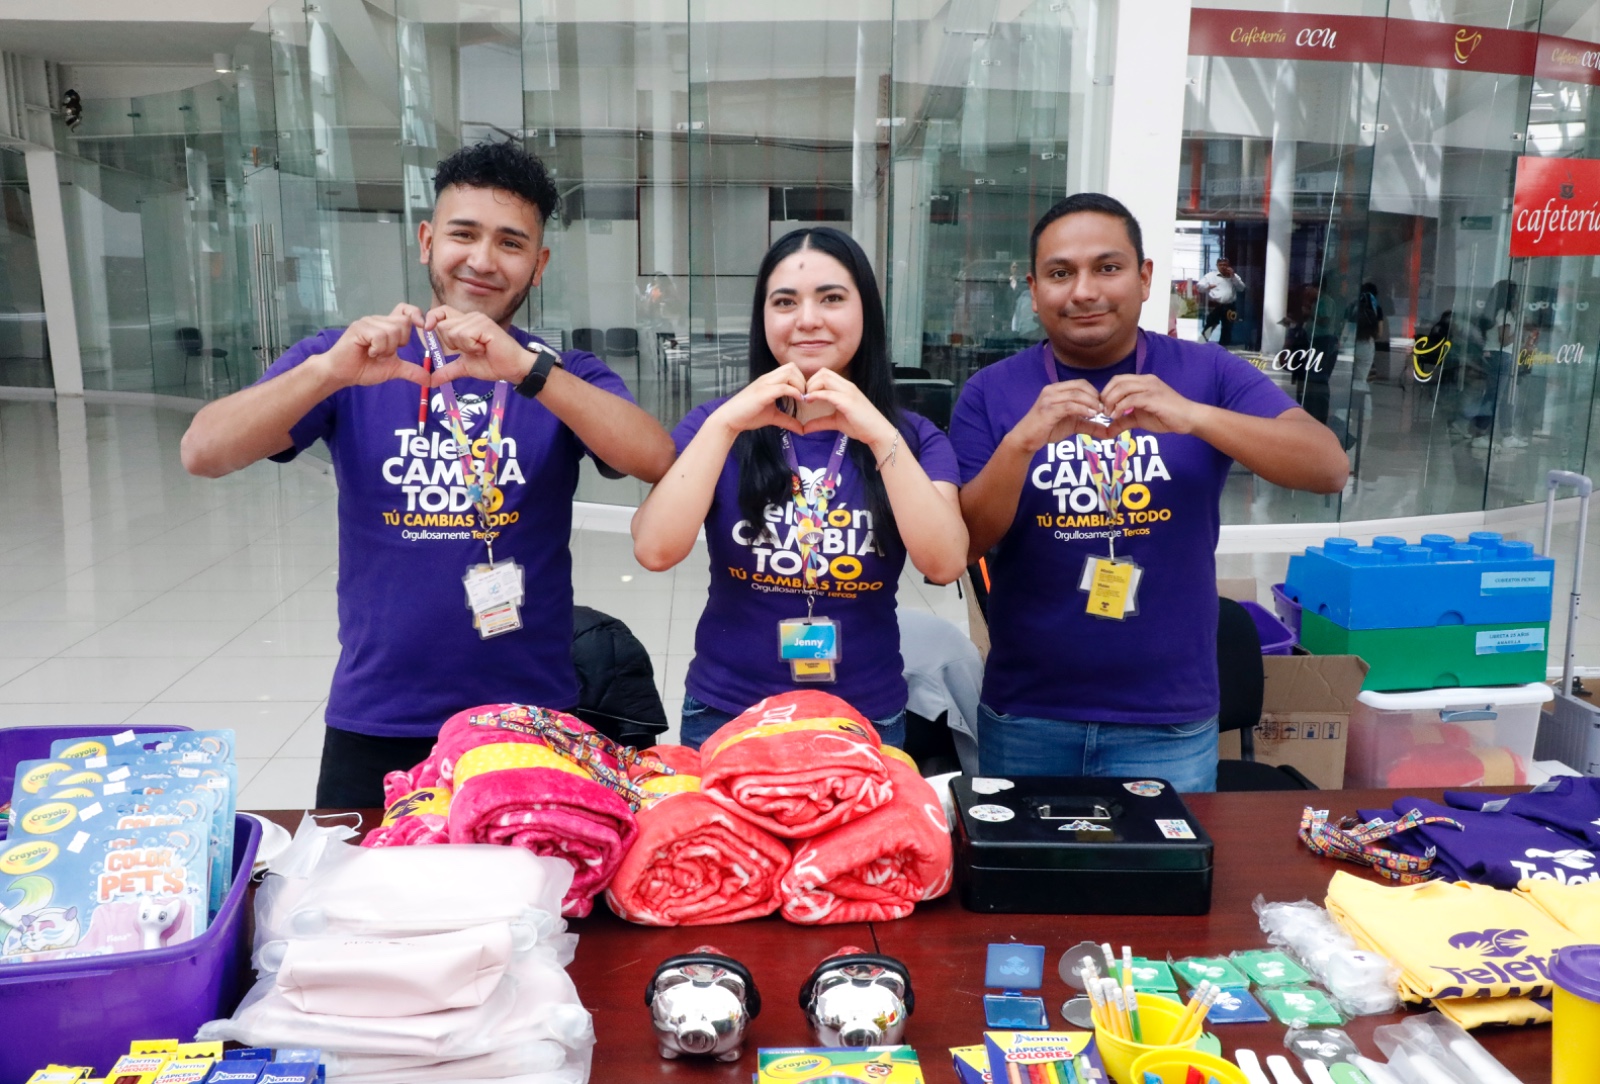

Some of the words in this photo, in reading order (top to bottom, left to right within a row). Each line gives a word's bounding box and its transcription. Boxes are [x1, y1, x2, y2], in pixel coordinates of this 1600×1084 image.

[1230, 26, 1287, 46] Cafetería
[1295, 28, 1337, 49] CCU
[1556, 342, 1585, 364] CCU
[1271, 348, 1324, 373] CCU
[394, 429, 517, 460] Teleón
[382, 509, 400, 526] TÚ
[403, 513, 475, 527] CAMBIAS
[487, 511, 520, 527] ODO
[1036, 511, 1053, 528] TÚ
[1128, 508, 1172, 525] TODO
[401, 529, 471, 542] Orgullosamente
[1123, 527, 1151, 538] Tercos
[728, 566, 748, 580] TÚ
[752, 573, 831, 591] CAMBAS
[835, 581, 884, 592] TODO
[794, 637, 824, 649] Jenny
[31, 808, 68, 822] Crayola
[8, 846, 48, 862] Crayola
[108, 850, 172, 872] COLOR
[101, 869, 185, 900] PETS
[187, 886, 199, 895] 3+
[1429, 953, 1554, 984] Telet
[1014, 1033, 1069, 1044] Norma
[1007, 1050, 1073, 1060] COLORES
[117, 1057, 162, 1068] Norma
[165, 1063, 206, 1072] Norma
[775, 1058, 818, 1070] Crayola
[155, 1075, 201, 1084] CHEQUEO
[209, 1071, 256, 1083] Norma
[259, 1075, 304, 1084] Norma
